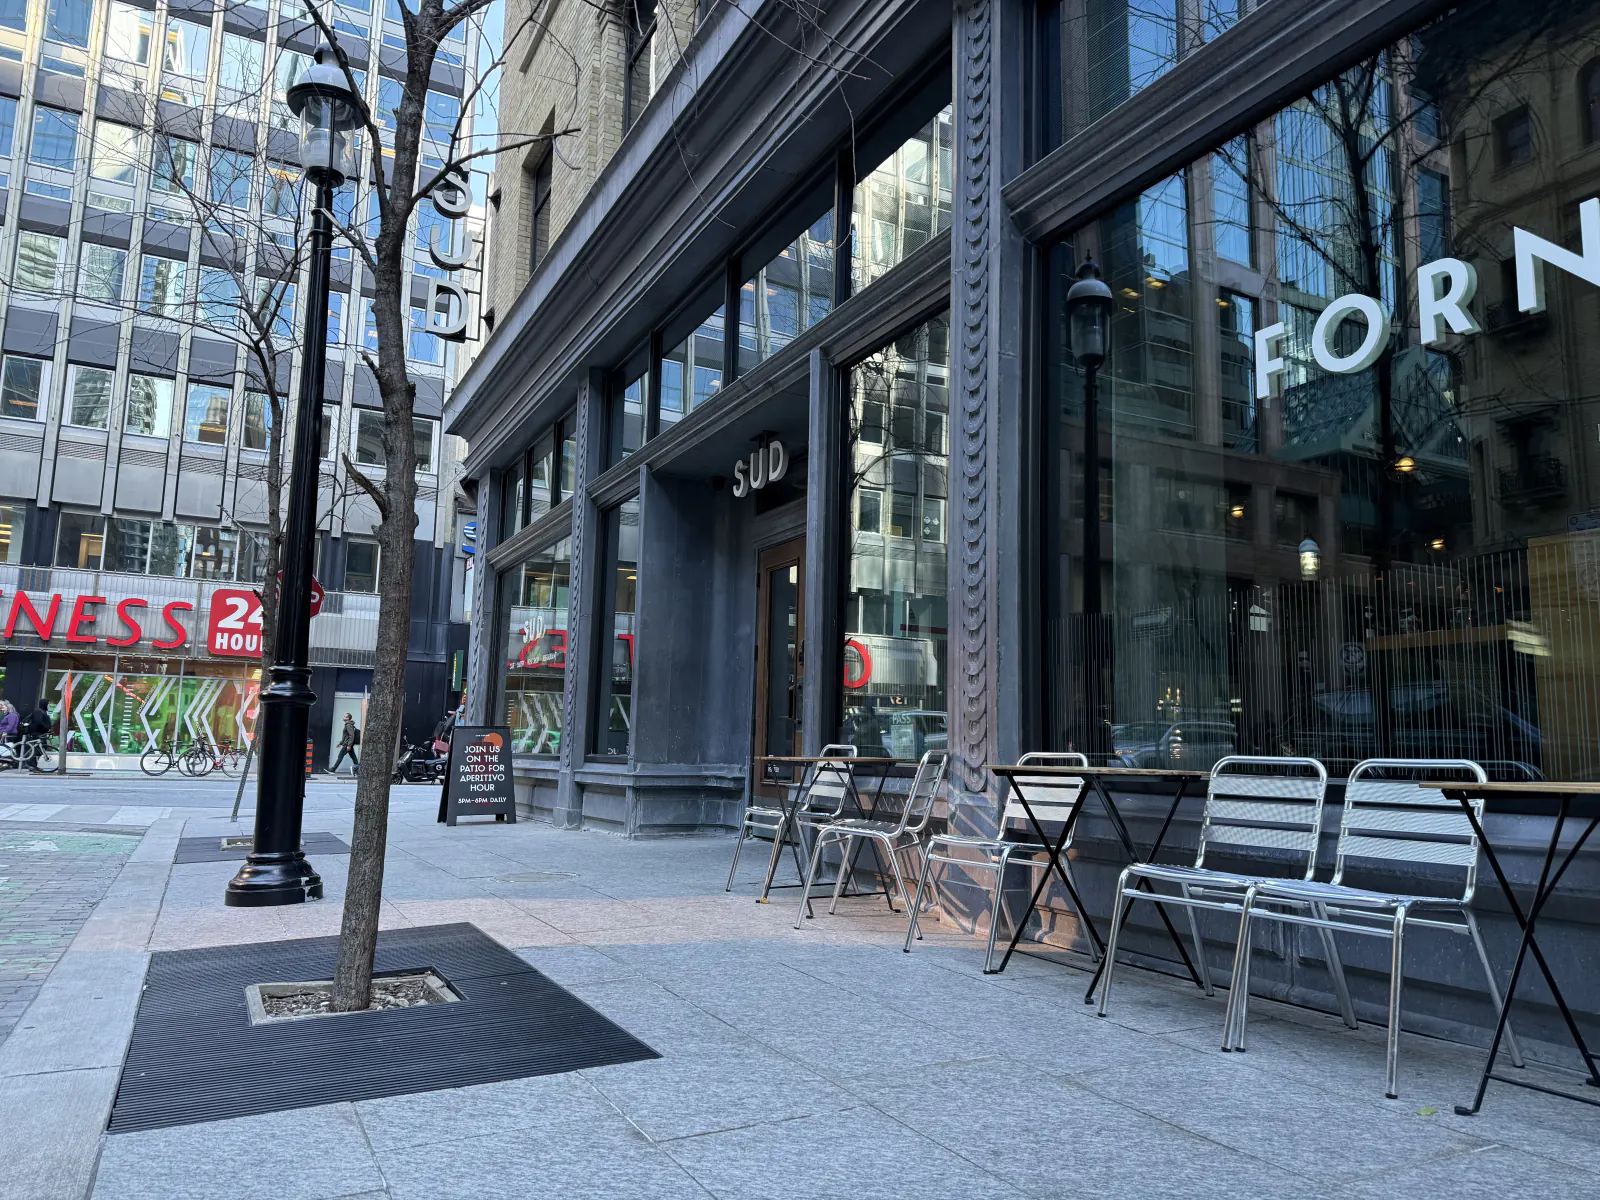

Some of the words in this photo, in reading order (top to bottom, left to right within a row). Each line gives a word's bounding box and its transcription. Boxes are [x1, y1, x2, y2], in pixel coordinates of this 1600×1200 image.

[427, 163, 473, 342] SUD
[1254, 197, 1600, 404] FORN
[733, 440, 789, 498] SUD
[0, 590, 194, 649] NESS
[215, 632, 264, 652] HOU
[460, 765, 486, 773] PATIO
[466, 755, 481, 763] ON
[484, 755, 499, 763] THE
[460, 774, 505, 782] APERITIVO
[470, 784, 495, 792] HOUR
